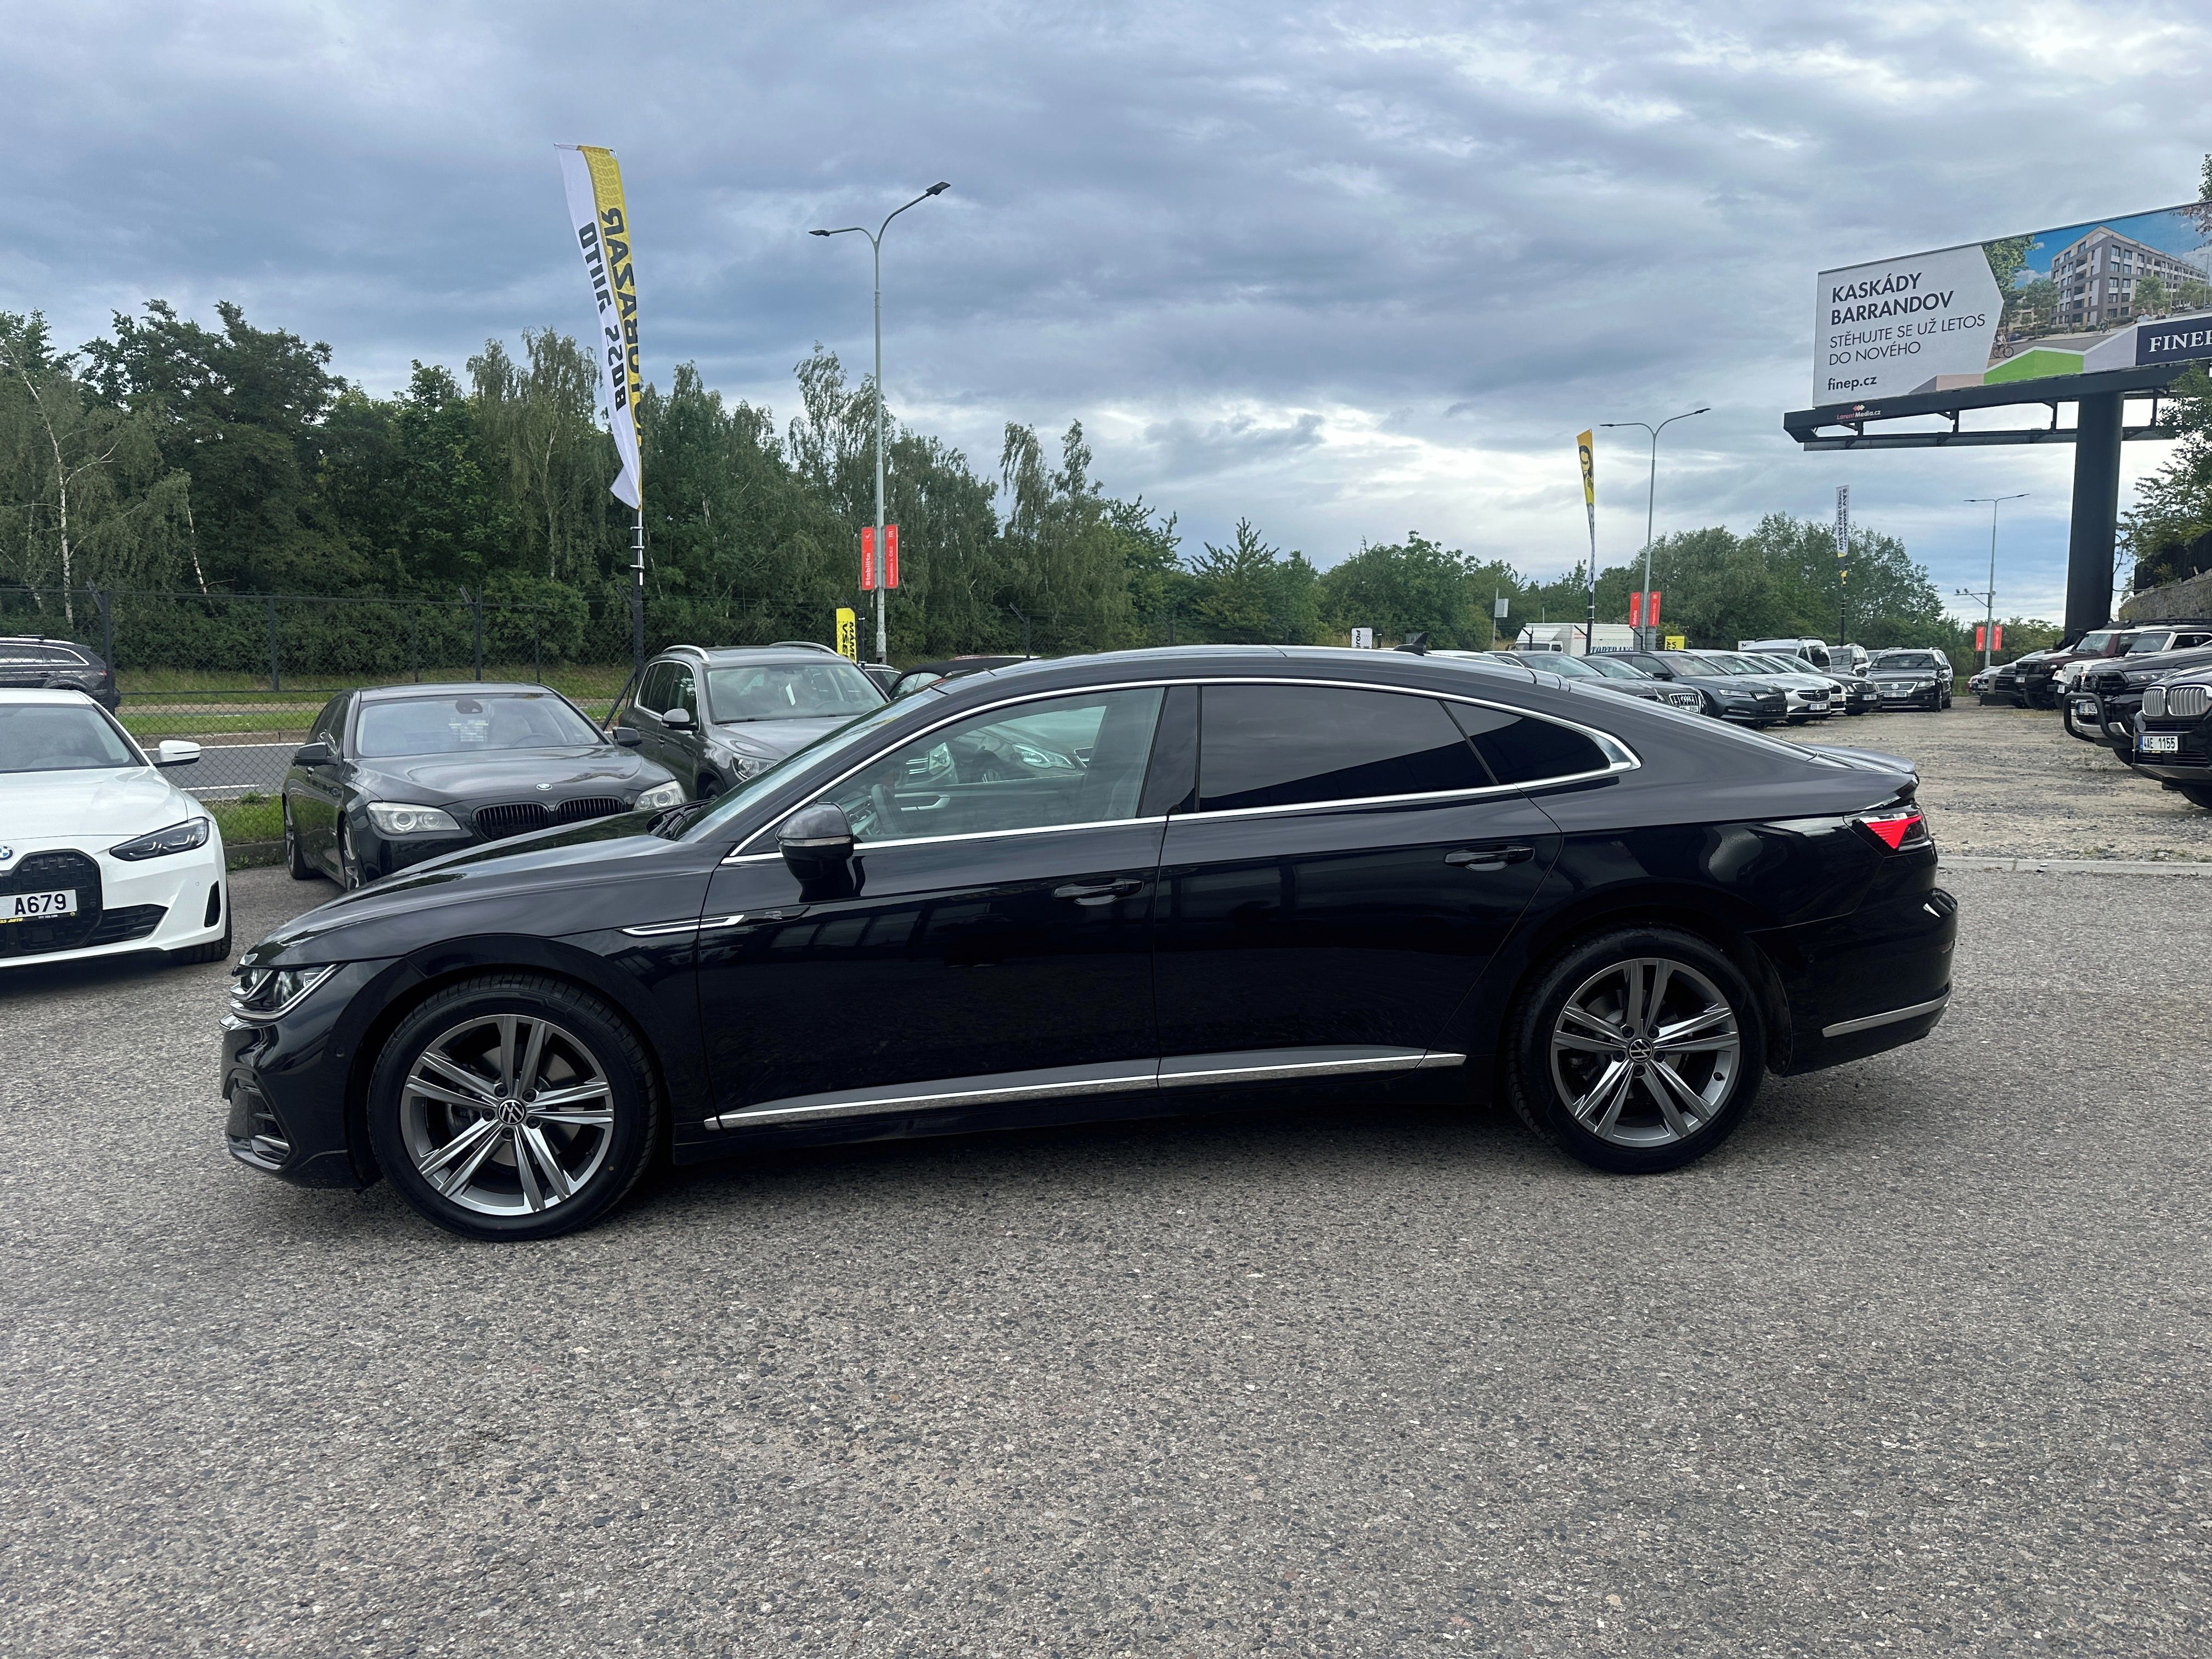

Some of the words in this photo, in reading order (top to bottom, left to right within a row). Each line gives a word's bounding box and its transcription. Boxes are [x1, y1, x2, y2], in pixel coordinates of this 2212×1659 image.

[1832, 272, 1922, 303] KASKÁDY
[1831, 290, 1954, 325] BARRANDOV
[1830, 328, 1893, 348] STĚHUJTE
[1897, 324, 1912, 337] SE
[1917, 318, 1937, 335] UŽ
[1942, 314, 1985, 332] LETOS
[1829, 352, 1851, 365] DO
[1855, 341, 1921, 362] NOVÉHO
[1828, 376, 1877, 391] finep.cz
[2144, 737, 2153, 748] 4AE
[2159, 737, 2175, 749] 1155
[15, 893, 66, 916] A679
